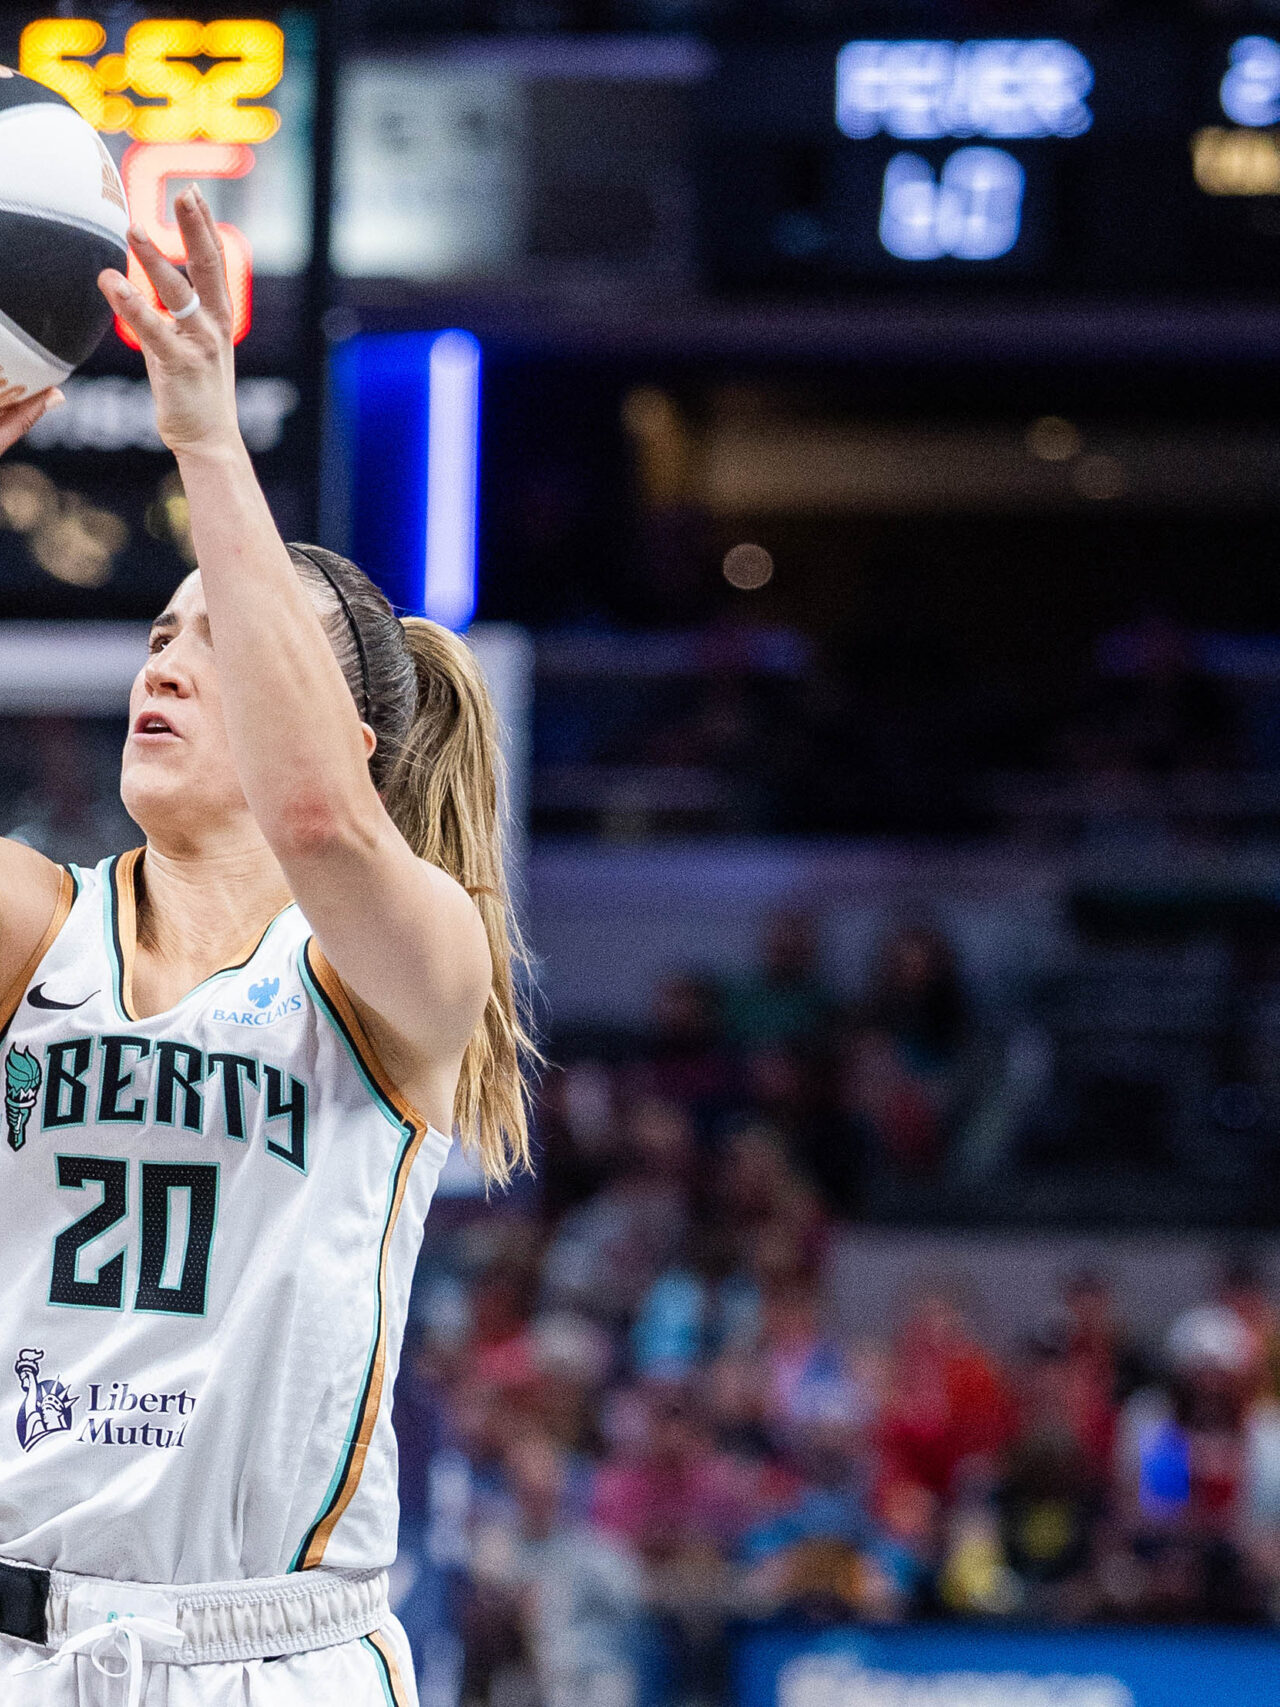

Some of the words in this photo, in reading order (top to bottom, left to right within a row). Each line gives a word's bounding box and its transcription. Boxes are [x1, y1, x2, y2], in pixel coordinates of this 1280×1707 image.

[213, 994, 302, 1026] BARCLAYS
[47, 1153, 220, 1318] 20
[75, 1417, 189, 1449] Mutul
